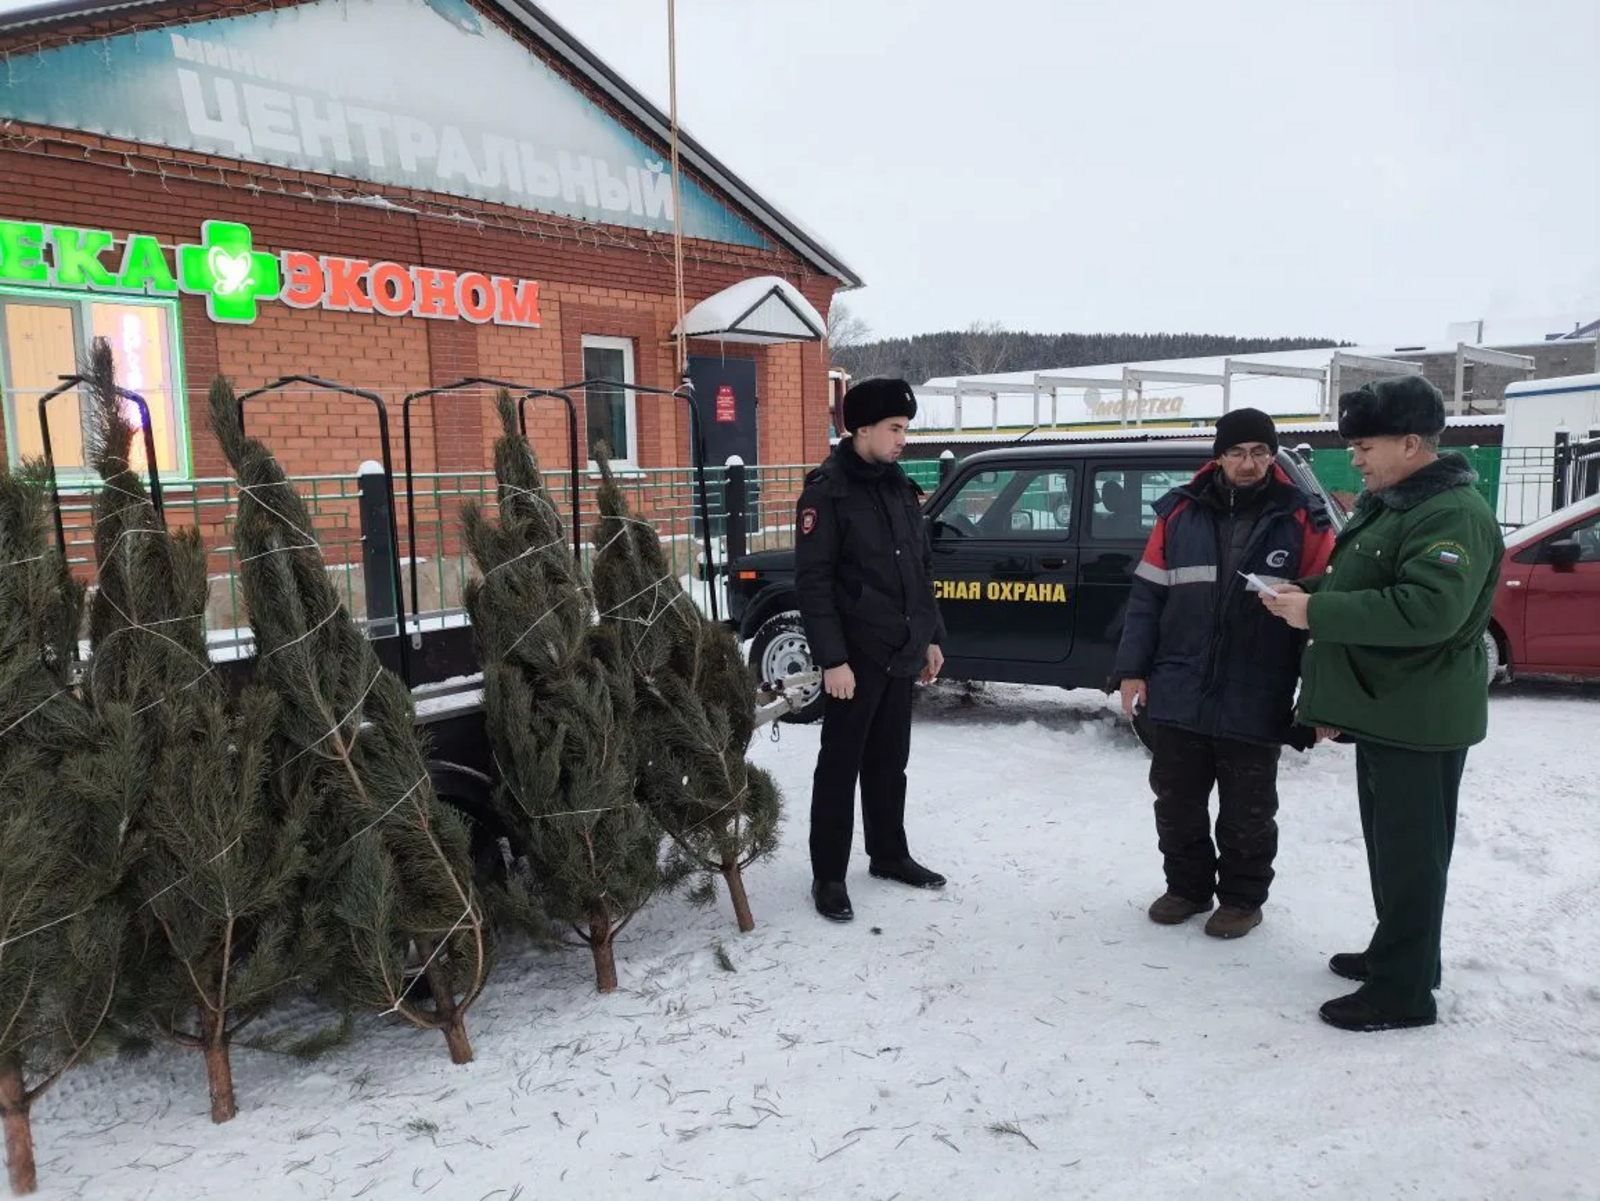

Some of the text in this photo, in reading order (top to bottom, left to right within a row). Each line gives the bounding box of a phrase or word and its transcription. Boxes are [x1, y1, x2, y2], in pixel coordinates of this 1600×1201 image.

[177, 67, 674, 221] ЦЕНТРАЛЬНЫЙ
[0, 220, 542, 328] ЕКА ЭКОНОМ
[987, 582, 1066, 602] ОХРАНА
